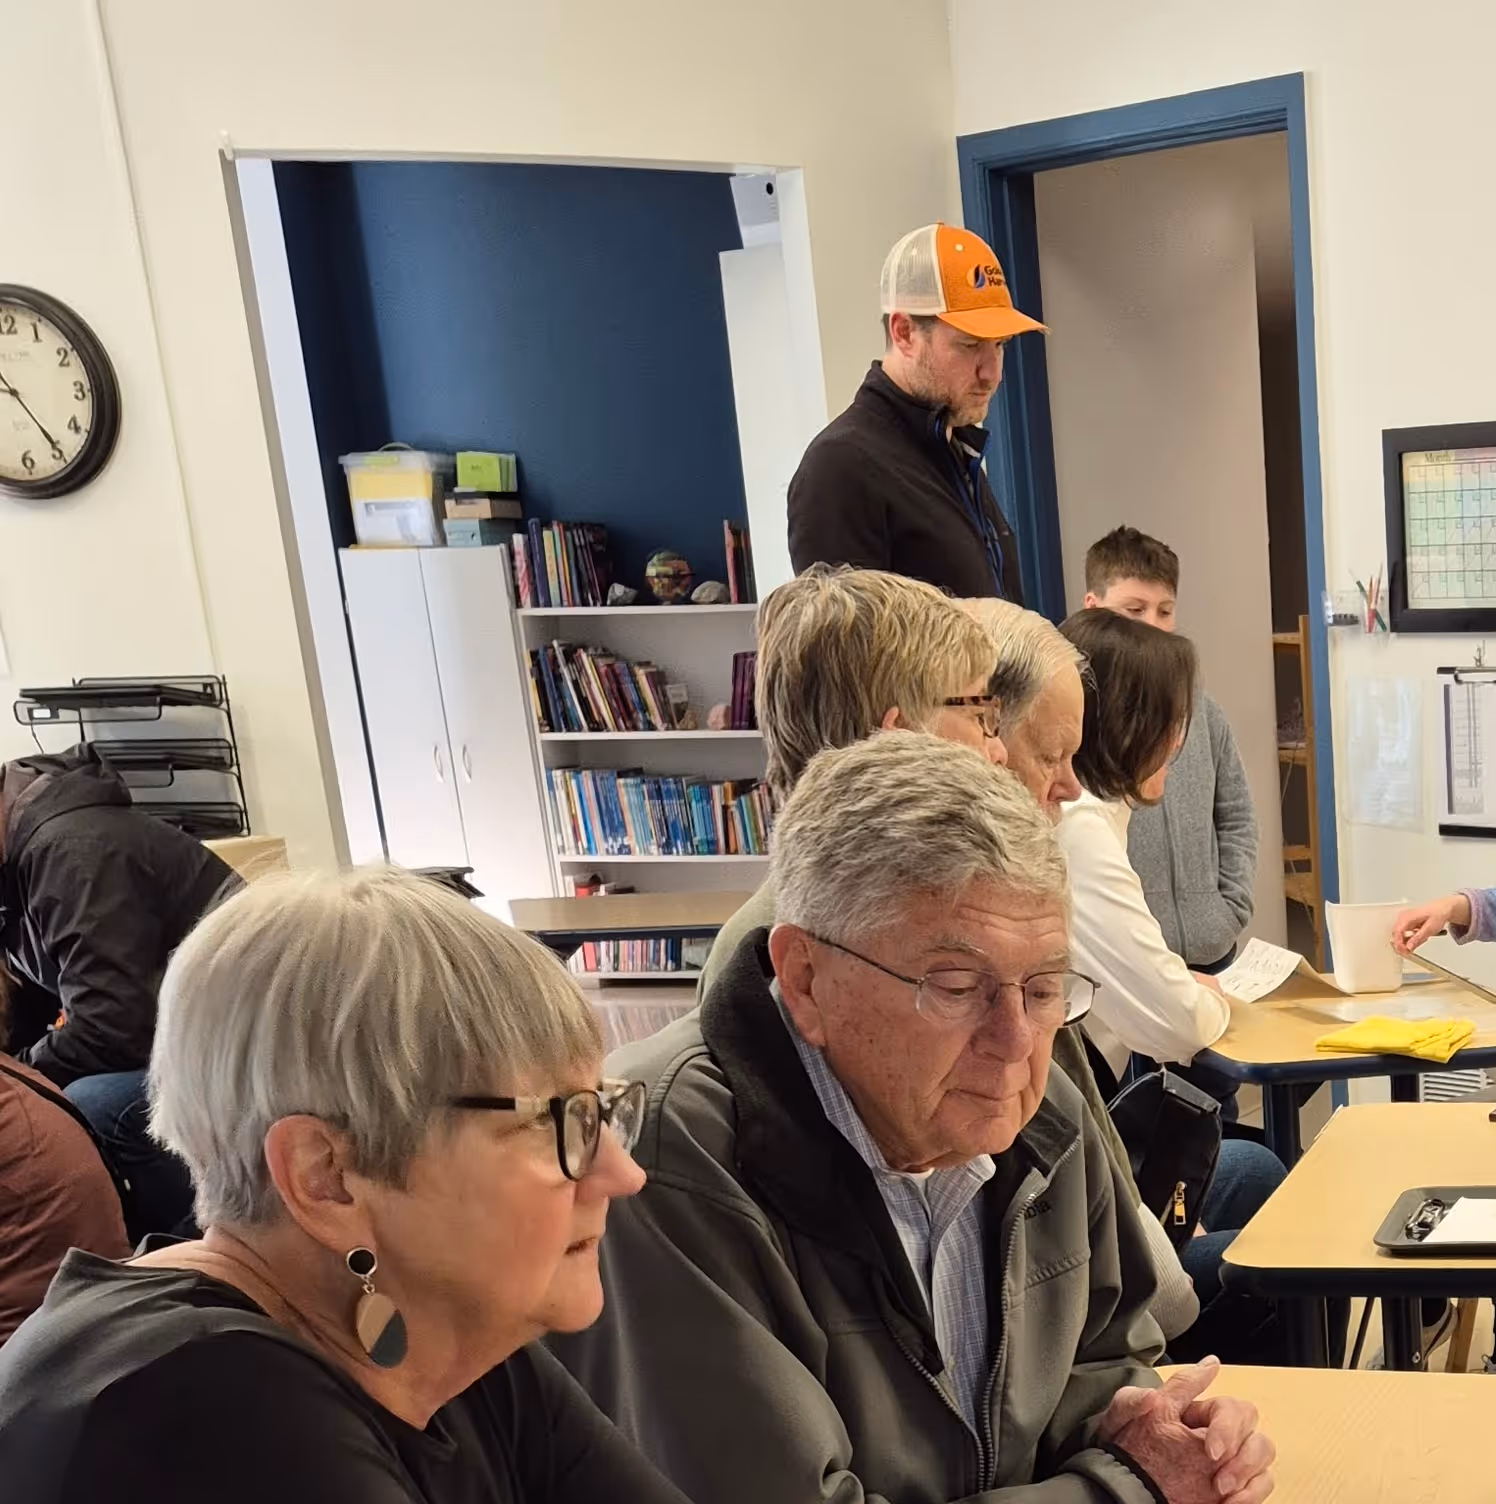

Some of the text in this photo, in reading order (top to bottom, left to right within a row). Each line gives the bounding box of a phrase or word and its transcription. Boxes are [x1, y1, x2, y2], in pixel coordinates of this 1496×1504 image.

[30, 321, 43, 344] 1
[56, 347, 71, 368] 2
[72, 380, 86, 402] 3
[67, 414, 82, 436] 4
[21, 450, 36, 476] 6
